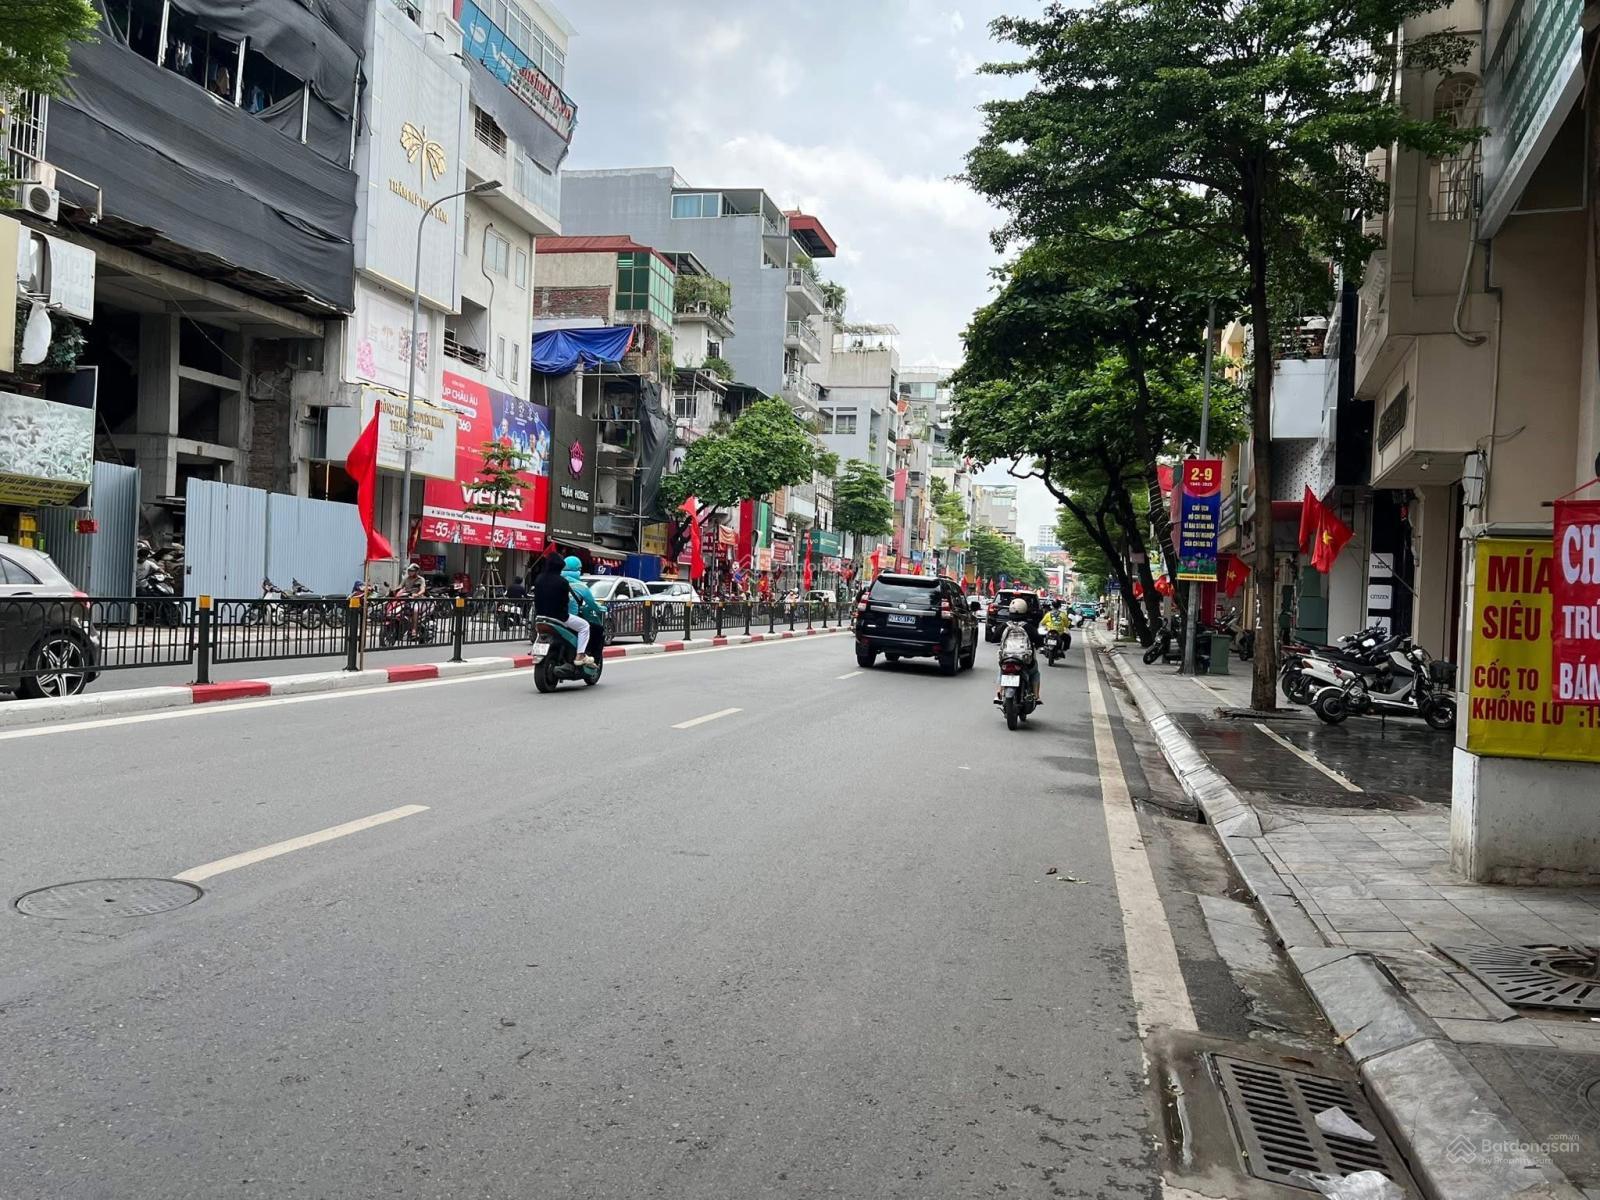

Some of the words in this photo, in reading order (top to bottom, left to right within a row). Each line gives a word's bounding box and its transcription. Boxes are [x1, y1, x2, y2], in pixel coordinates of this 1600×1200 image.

[1191, 467, 1213, 481] 2-9
[435, 522, 448, 537] 5G
[493, 529, 504, 543] 5G
[1487, 548, 1553, 594] MÍA
[1482, 600, 1541, 641] SIÊU
[1474, 659, 1510, 690] CỐC
[1517, 667, 1539, 691] TO
[1472, 690, 1535, 724] KHỔNG
